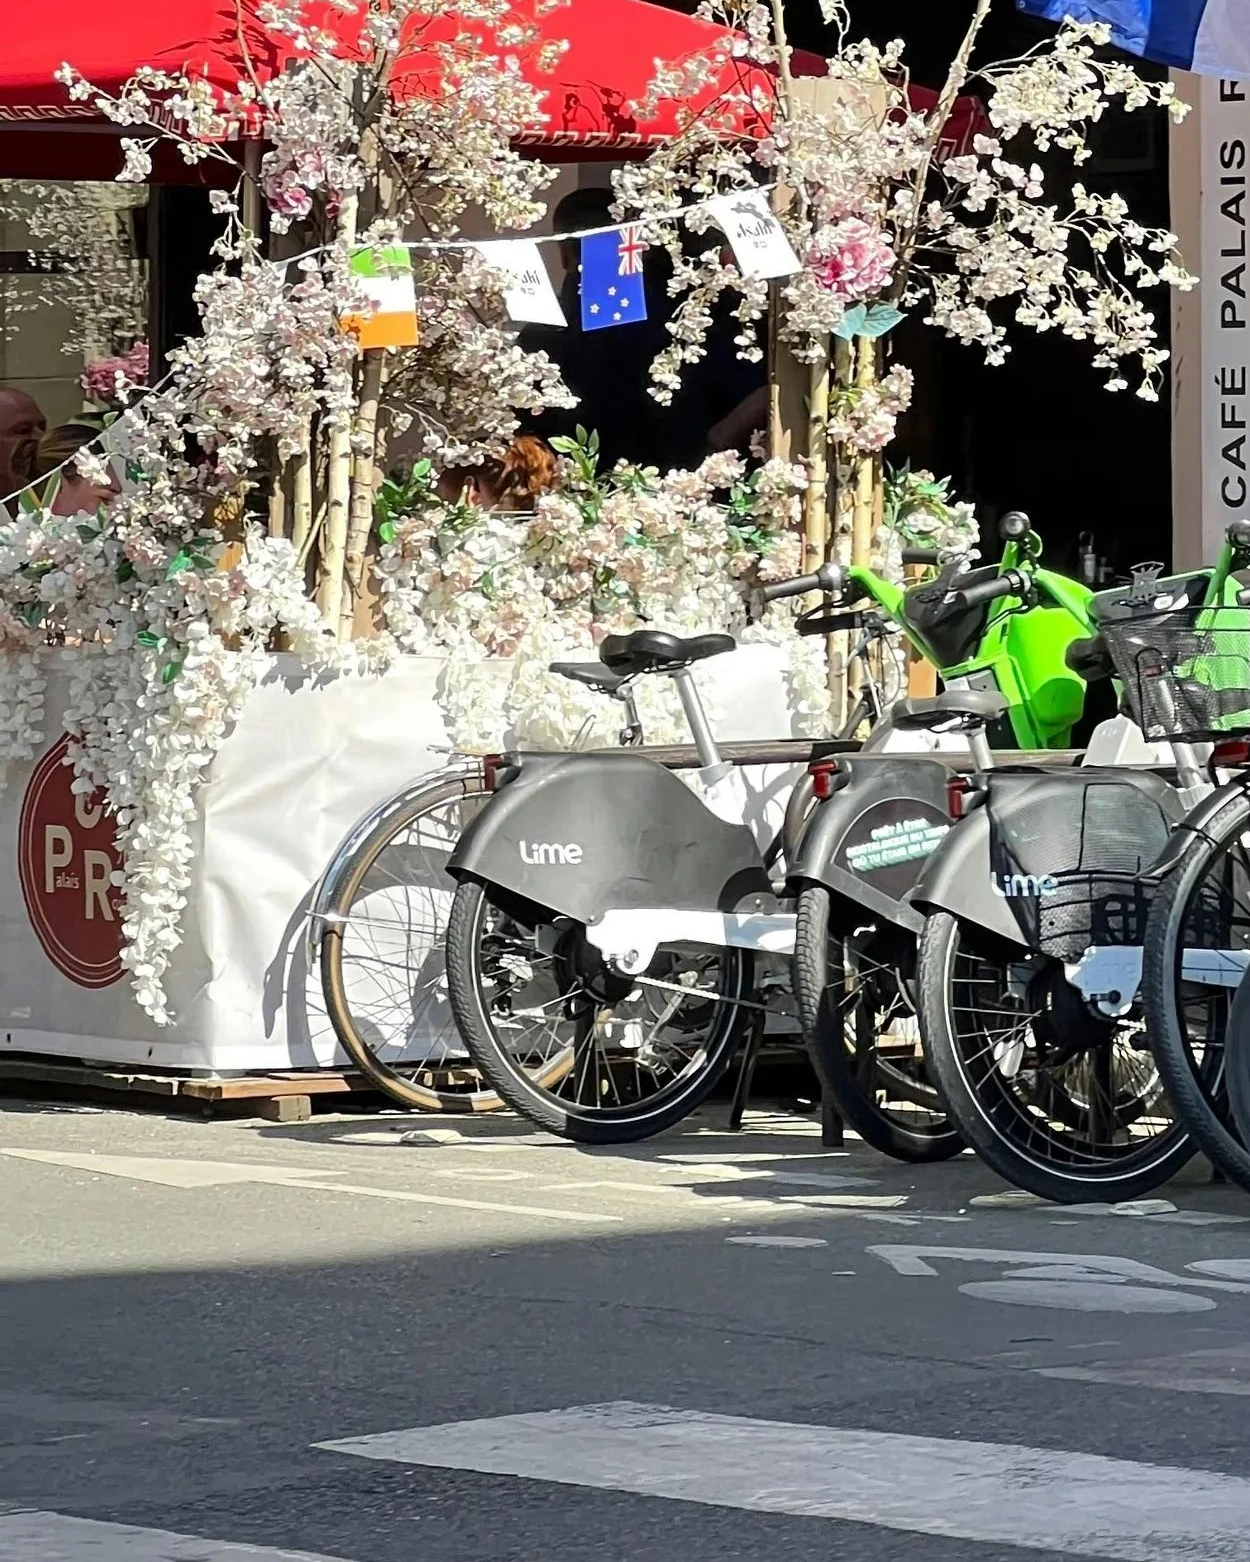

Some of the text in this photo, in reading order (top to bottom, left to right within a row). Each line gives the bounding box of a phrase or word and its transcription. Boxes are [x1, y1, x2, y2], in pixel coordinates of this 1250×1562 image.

[1220, 139, 1246, 328] PALAIS
[1214, 366, 1247, 508] CAFÉ
[519, 840, 583, 865] Lime
[990, 871, 1059, 898] Lime
